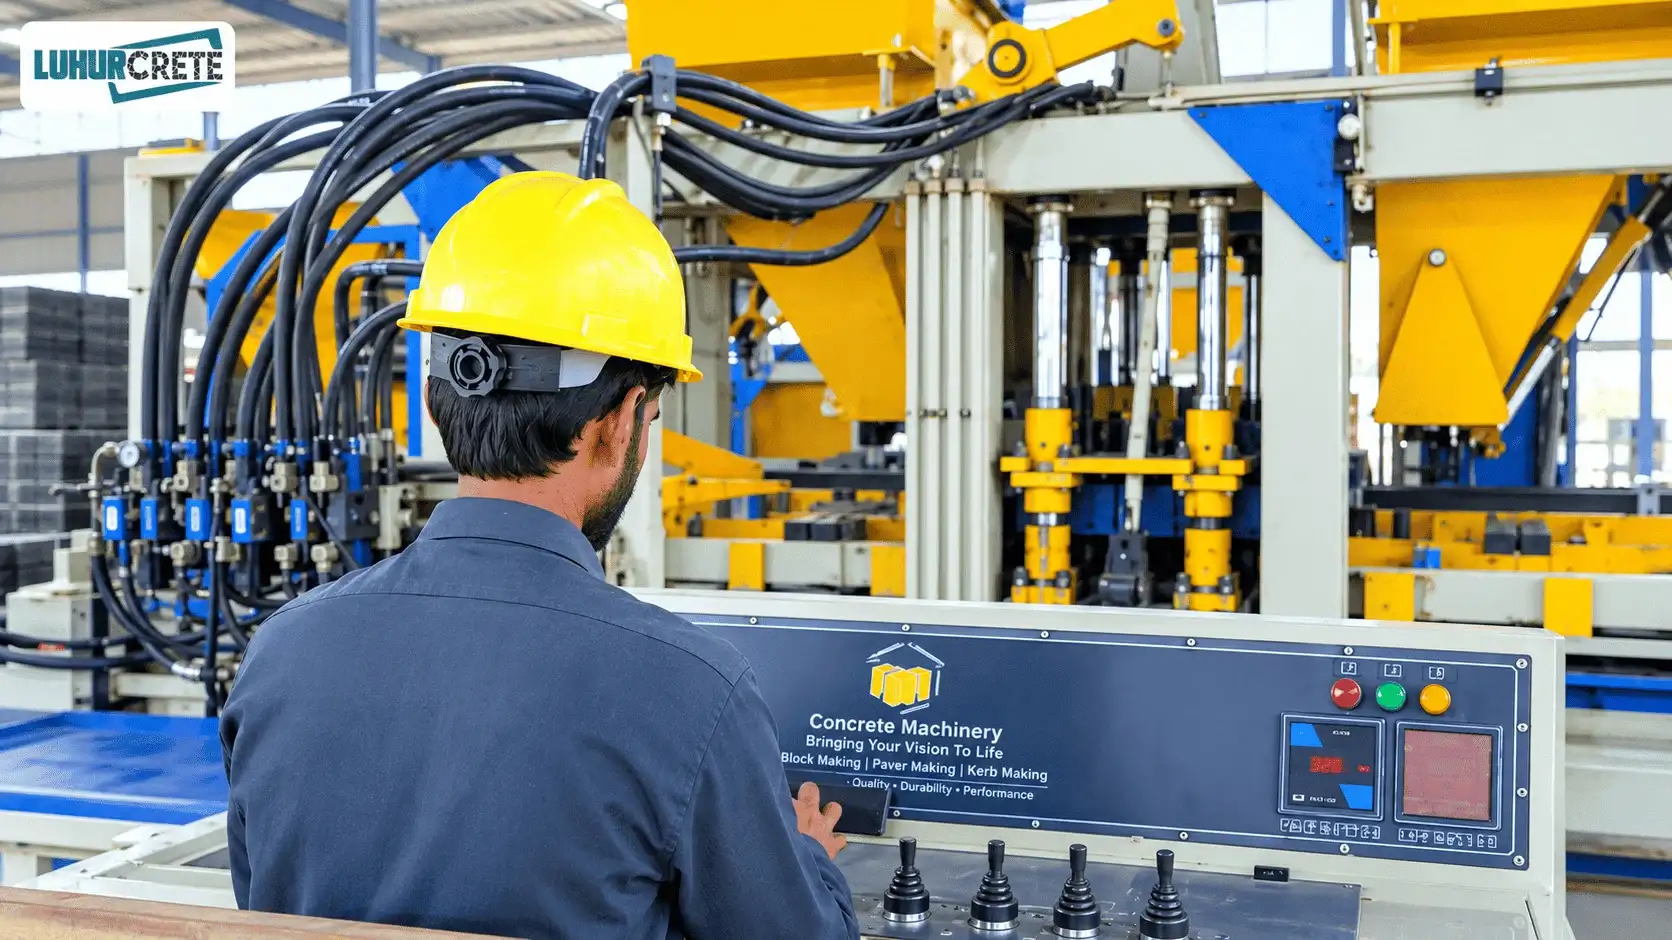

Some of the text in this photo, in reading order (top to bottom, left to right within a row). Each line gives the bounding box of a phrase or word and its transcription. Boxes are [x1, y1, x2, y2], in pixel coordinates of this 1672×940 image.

[809, 713, 1003, 744] Concrete Machinery
[806, 734, 1004, 759] Bringing Your Vision To Life
[781, 752, 1048, 783] Block Making Paver Making Kerb Making
[852, 777, 1034, 800] Quality Durability Performance
